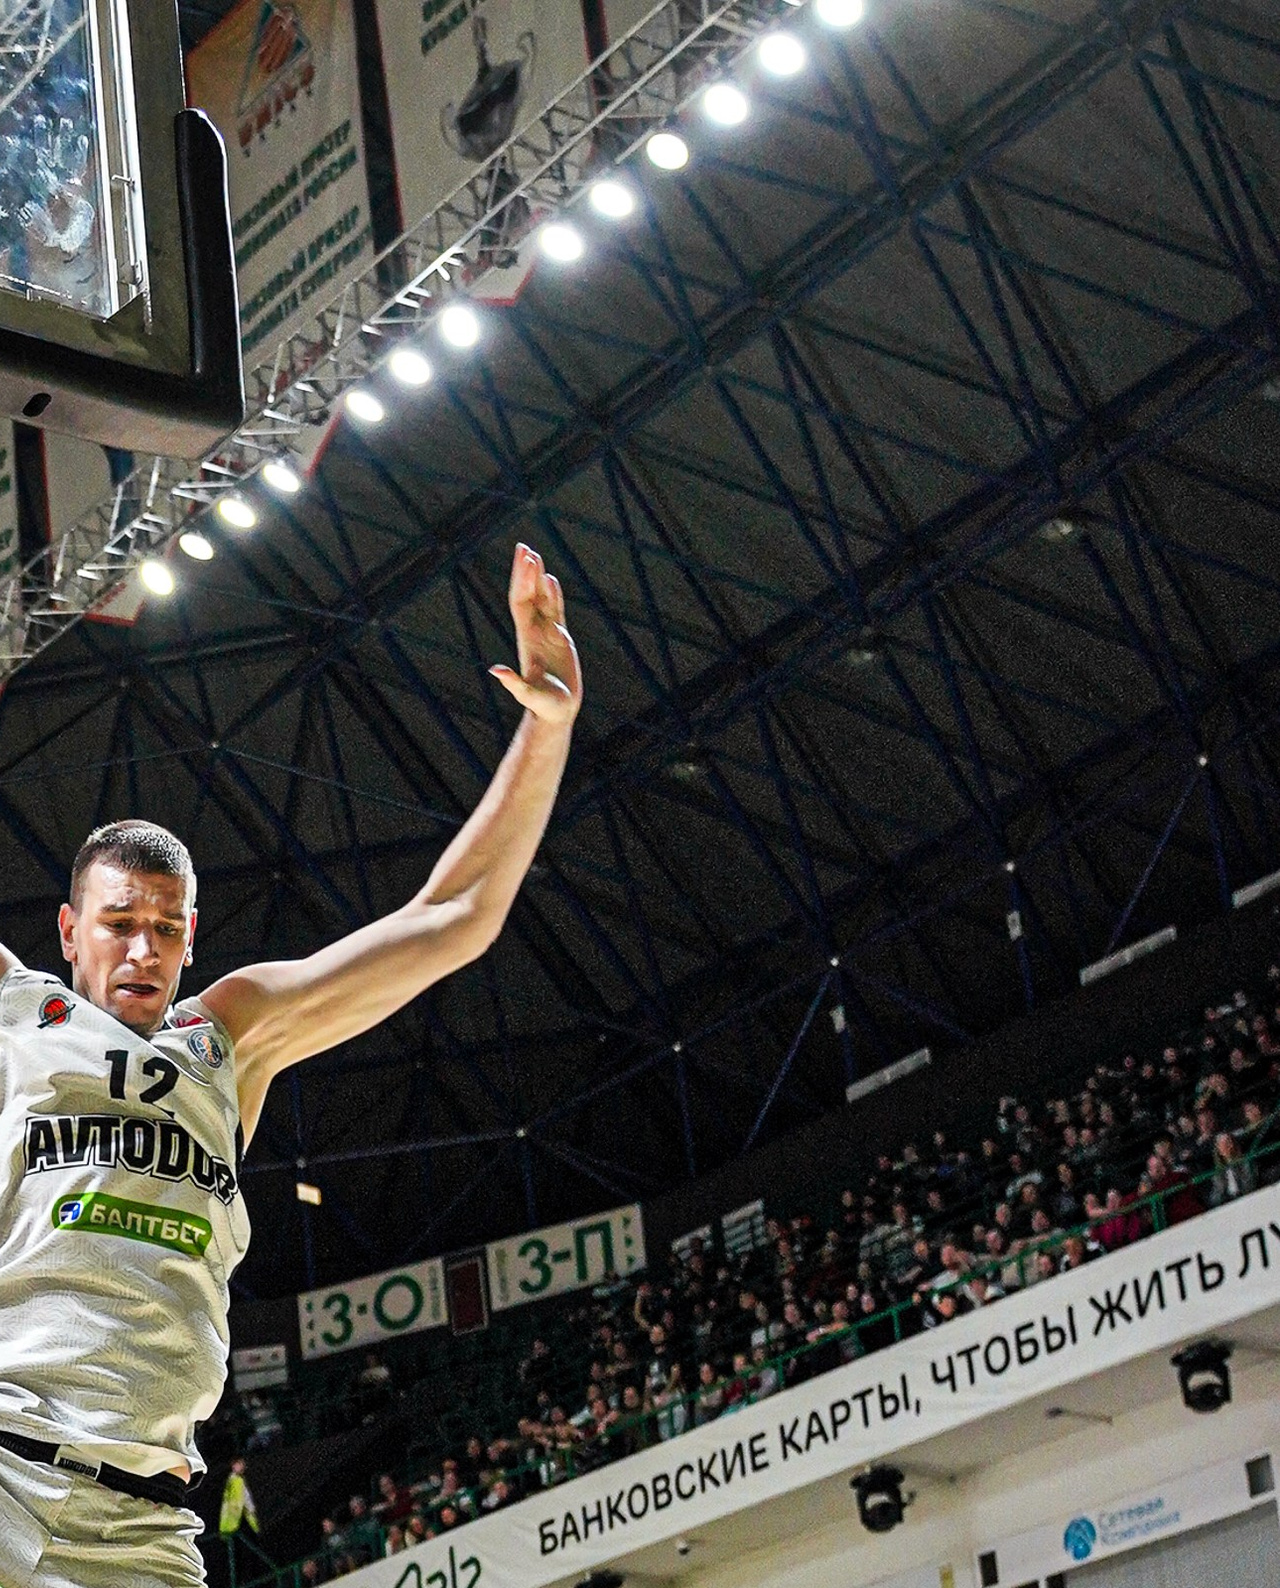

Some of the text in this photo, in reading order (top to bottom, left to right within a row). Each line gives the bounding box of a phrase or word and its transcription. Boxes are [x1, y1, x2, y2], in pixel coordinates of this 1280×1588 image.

[104, 1049, 180, 1119] 12
[89, 1203, 207, 1245] БАЛТБЕТ
[518, 1220, 614, 1294] 3-П
[321, 1273, 424, 1347] 3-О
[539, 1432, 769, 1556] БАНКОВСКИЕ
[780, 1373, 921, 1462] КАРТЫ,
[930, 1305, 1078, 1393] ЧТОБЫ
[1088, 1251, 1225, 1336] ЖИТЬ
